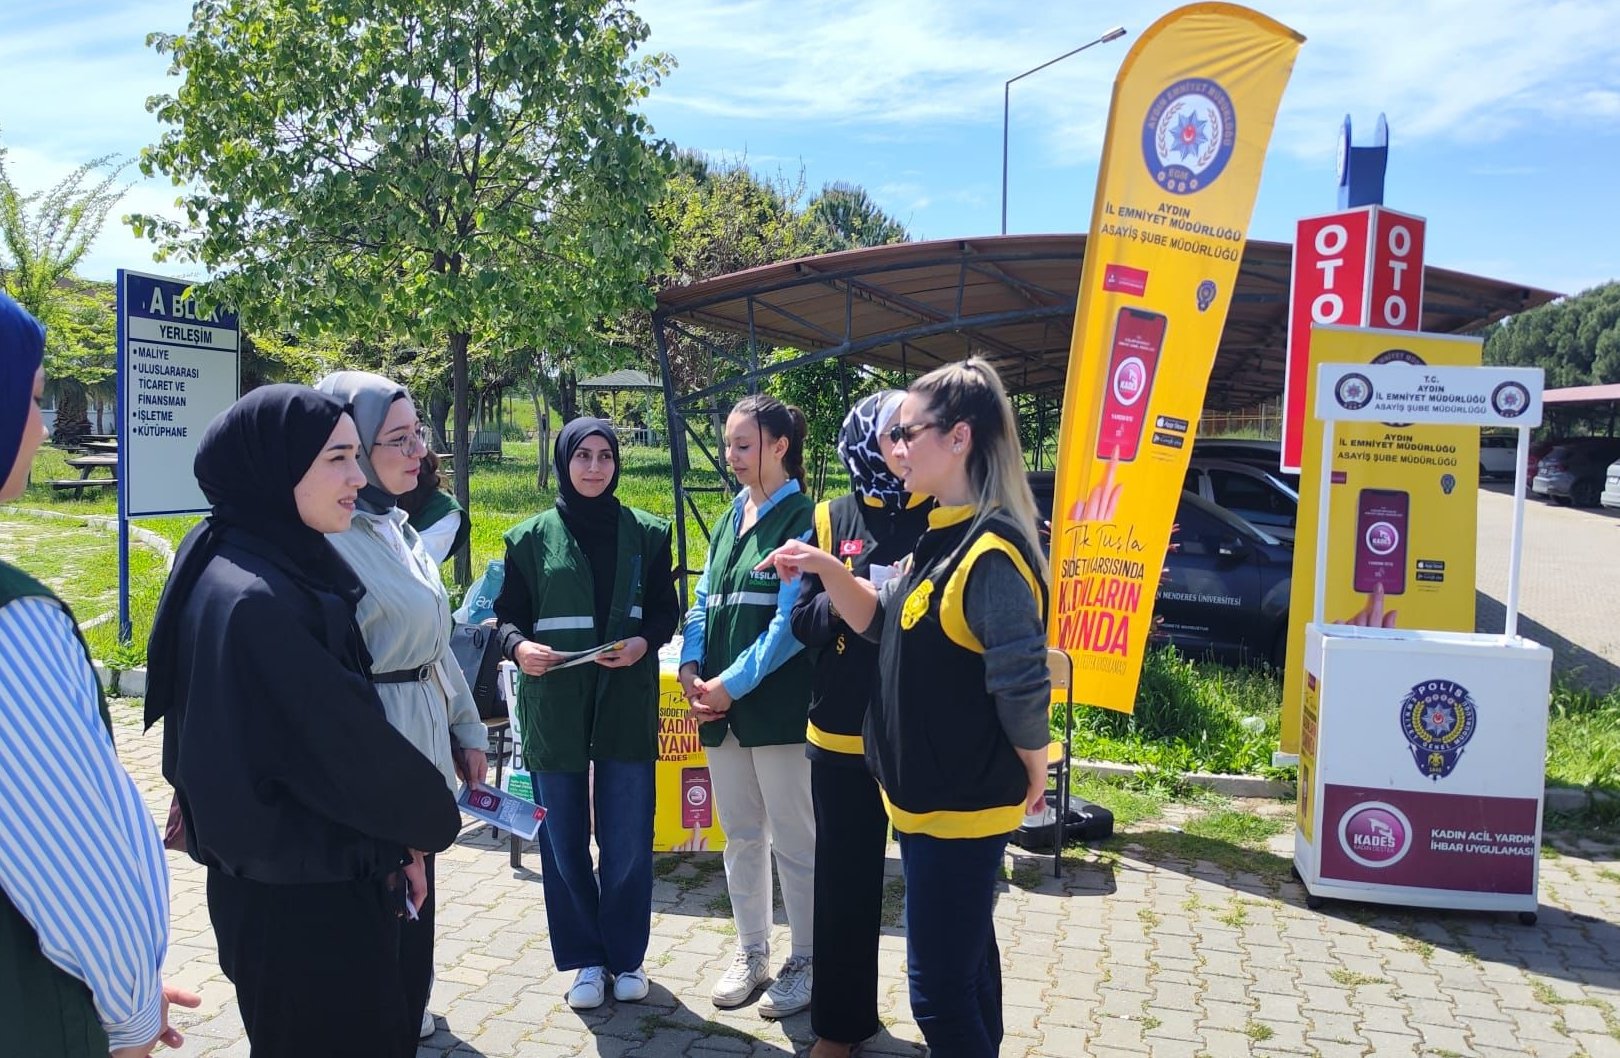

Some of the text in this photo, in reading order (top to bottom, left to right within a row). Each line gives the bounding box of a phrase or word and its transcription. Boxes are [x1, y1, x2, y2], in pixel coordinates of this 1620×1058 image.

[1158, 202, 1190, 218] AYDIN
[1105, 201, 1241, 242] İL EMNİYET MÜDÜRLÜĞÜ
[1101, 223, 1239, 262] ASAYİŞ ŞUBE MÜDÜRLÜĞÜ
[1311, 224, 1348, 324] OTO
[1384, 225, 1411, 326] OTO
[149, 286, 166, 316] A
[159, 324, 212, 345] YERLEŞİM
[138, 345, 169, 360] MALİYE
[138, 363, 200, 379] ULUSLARARASI
[138, 378, 185, 392] TİCARET VE
[1424, 375, 1439, 384] T.C.
[1417, 384, 1445, 393] AYDIN
[138, 393, 187, 407] FİNANSMAN
[1375, 391, 1486, 404] İL EMNİYET MÜDÜRLÜĞÜ
[138, 407, 173, 422] İŞLETME
[1375, 402, 1487, 414] ASAYİŞ ŞUBE MÜDÜRLÜĞÜ
[138, 422, 187, 437] KÜTÜPHANE
[1384, 433, 1413, 442] AYDIN
[1339, 437, 1456, 453] İL EMNİYET MÜDÜRLÜĞÜ
[1338, 451, 1457, 467] ASAYİŞ ŞUBE MÜDÜRLÜĞÜ
[1163, 592, 1197, 602] MENDERES
[1198, 593, 1241, 606] ÜNİVERSİTESİ
[658, 717, 697, 735] KADIN
[1353, 833, 1396, 849] KADES
[1431, 828, 1535, 845] KADIN ACİL YARDIM
[1430, 839, 1535, 856] İHBAR UYGULAMASI
